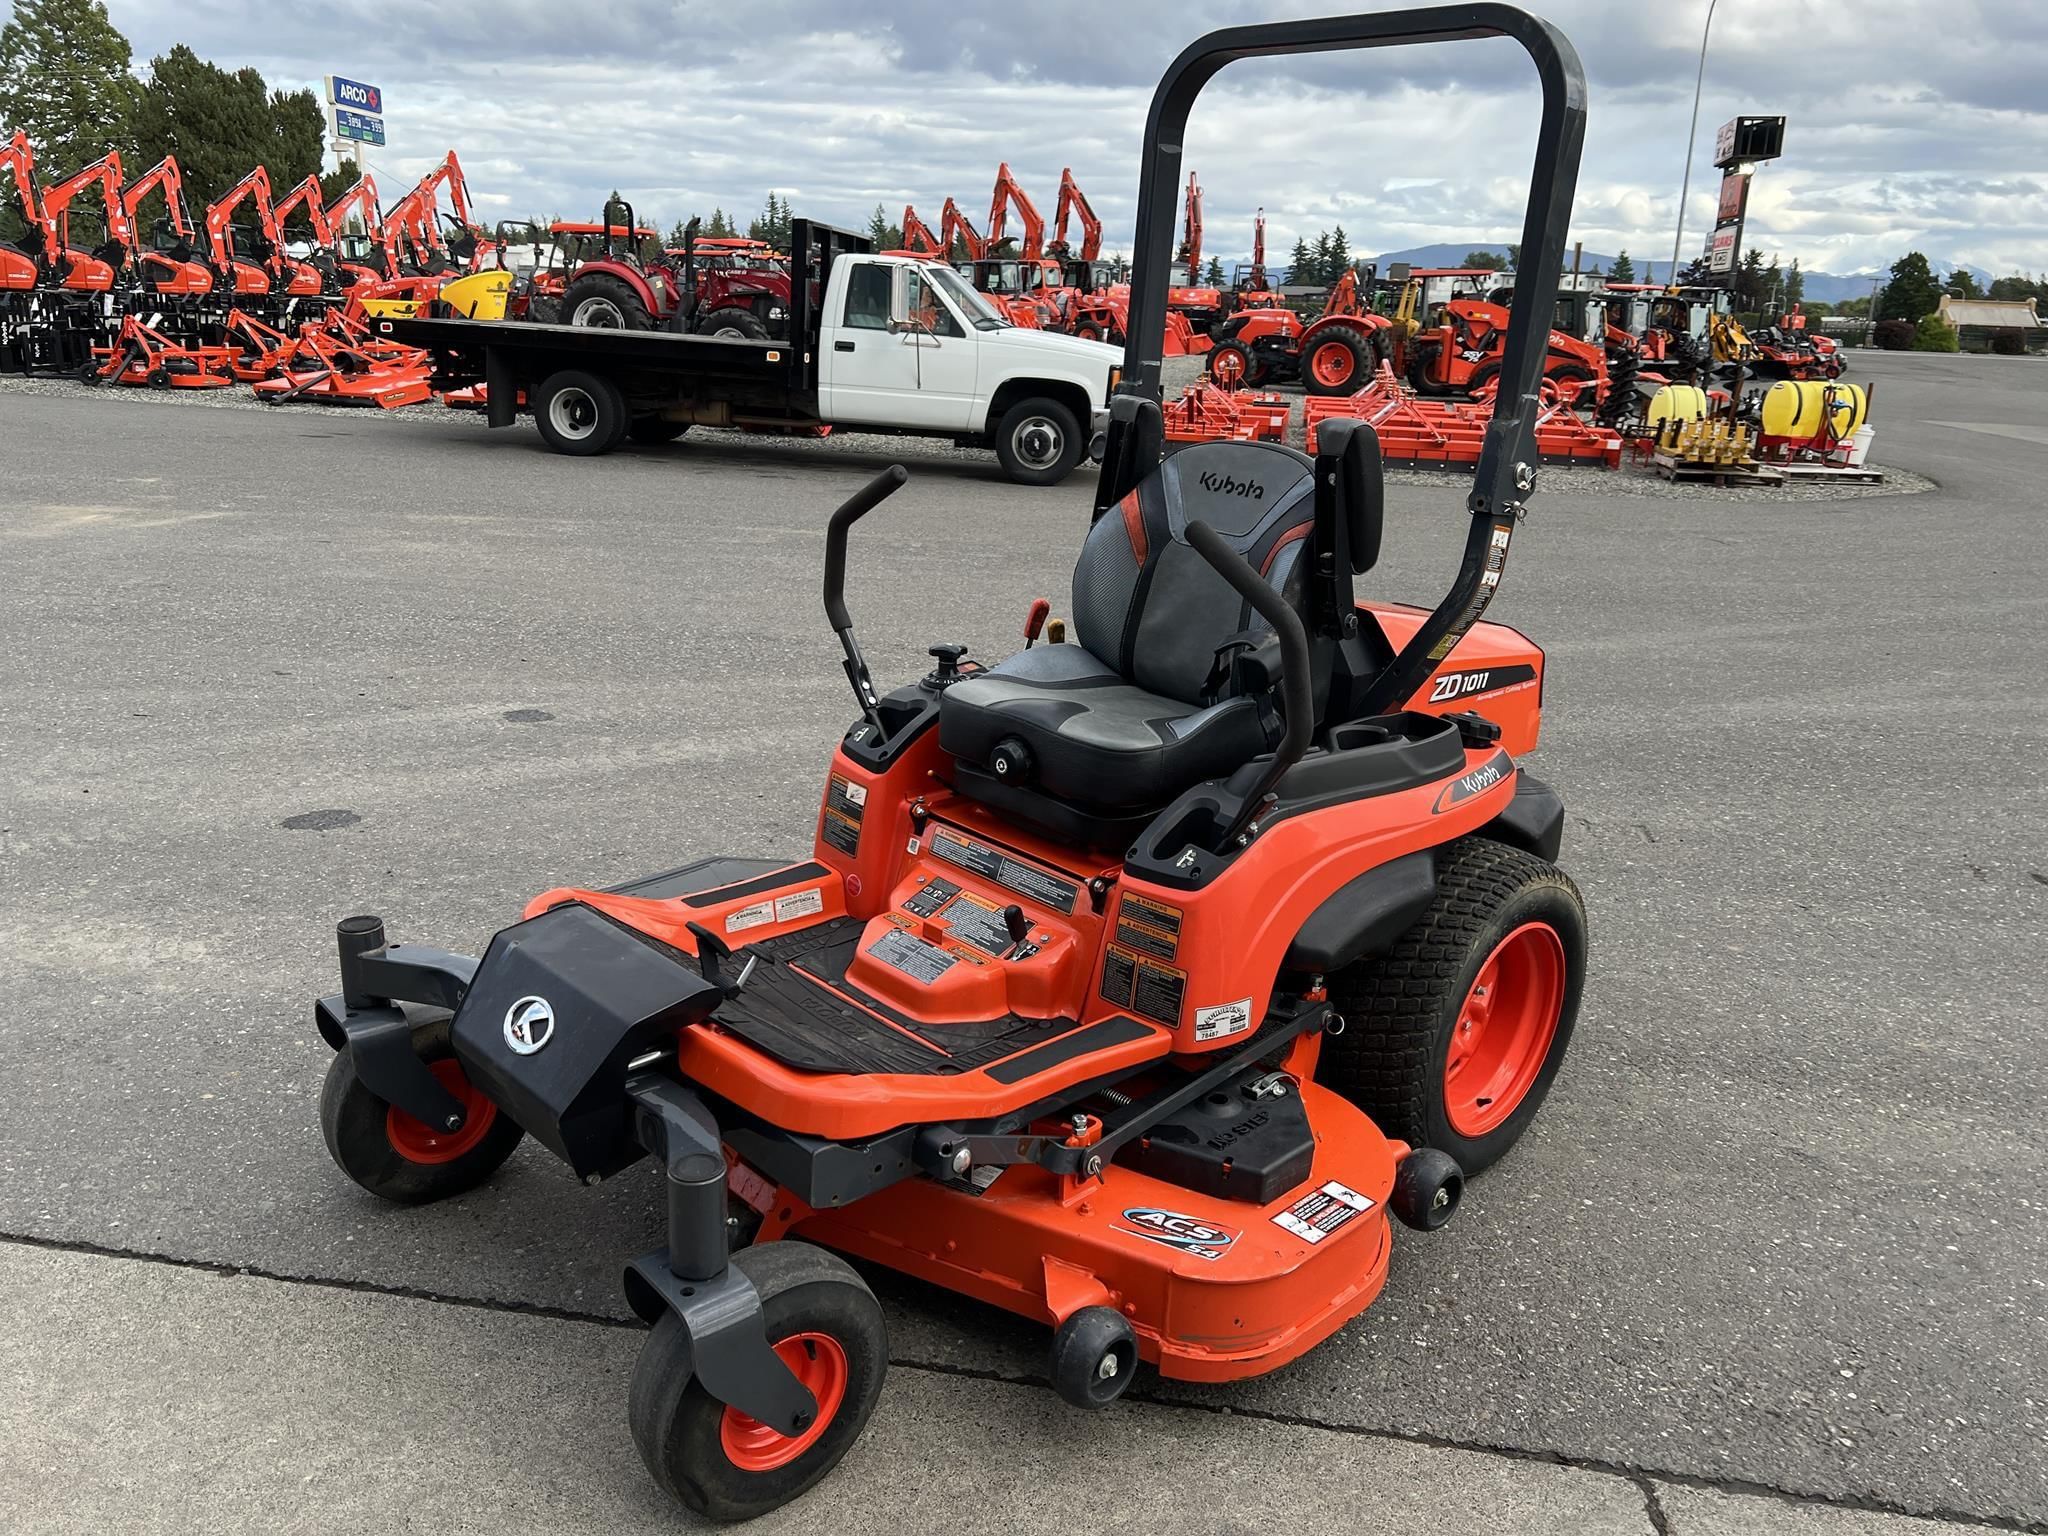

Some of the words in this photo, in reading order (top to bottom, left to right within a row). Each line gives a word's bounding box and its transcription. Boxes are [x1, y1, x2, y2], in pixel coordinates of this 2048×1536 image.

[341, 84, 367, 104] ARCO
[1200, 471, 1265, 500] Kubota
[1461, 766, 1500, 793] Kubota
[1141, 899, 1168, 912] WARNING
[1132, 923, 1168, 939] ADVERTENCIA
[1137, 1212, 1219, 1240] ACS
[1185, 1244, 1219, 1258] 54
